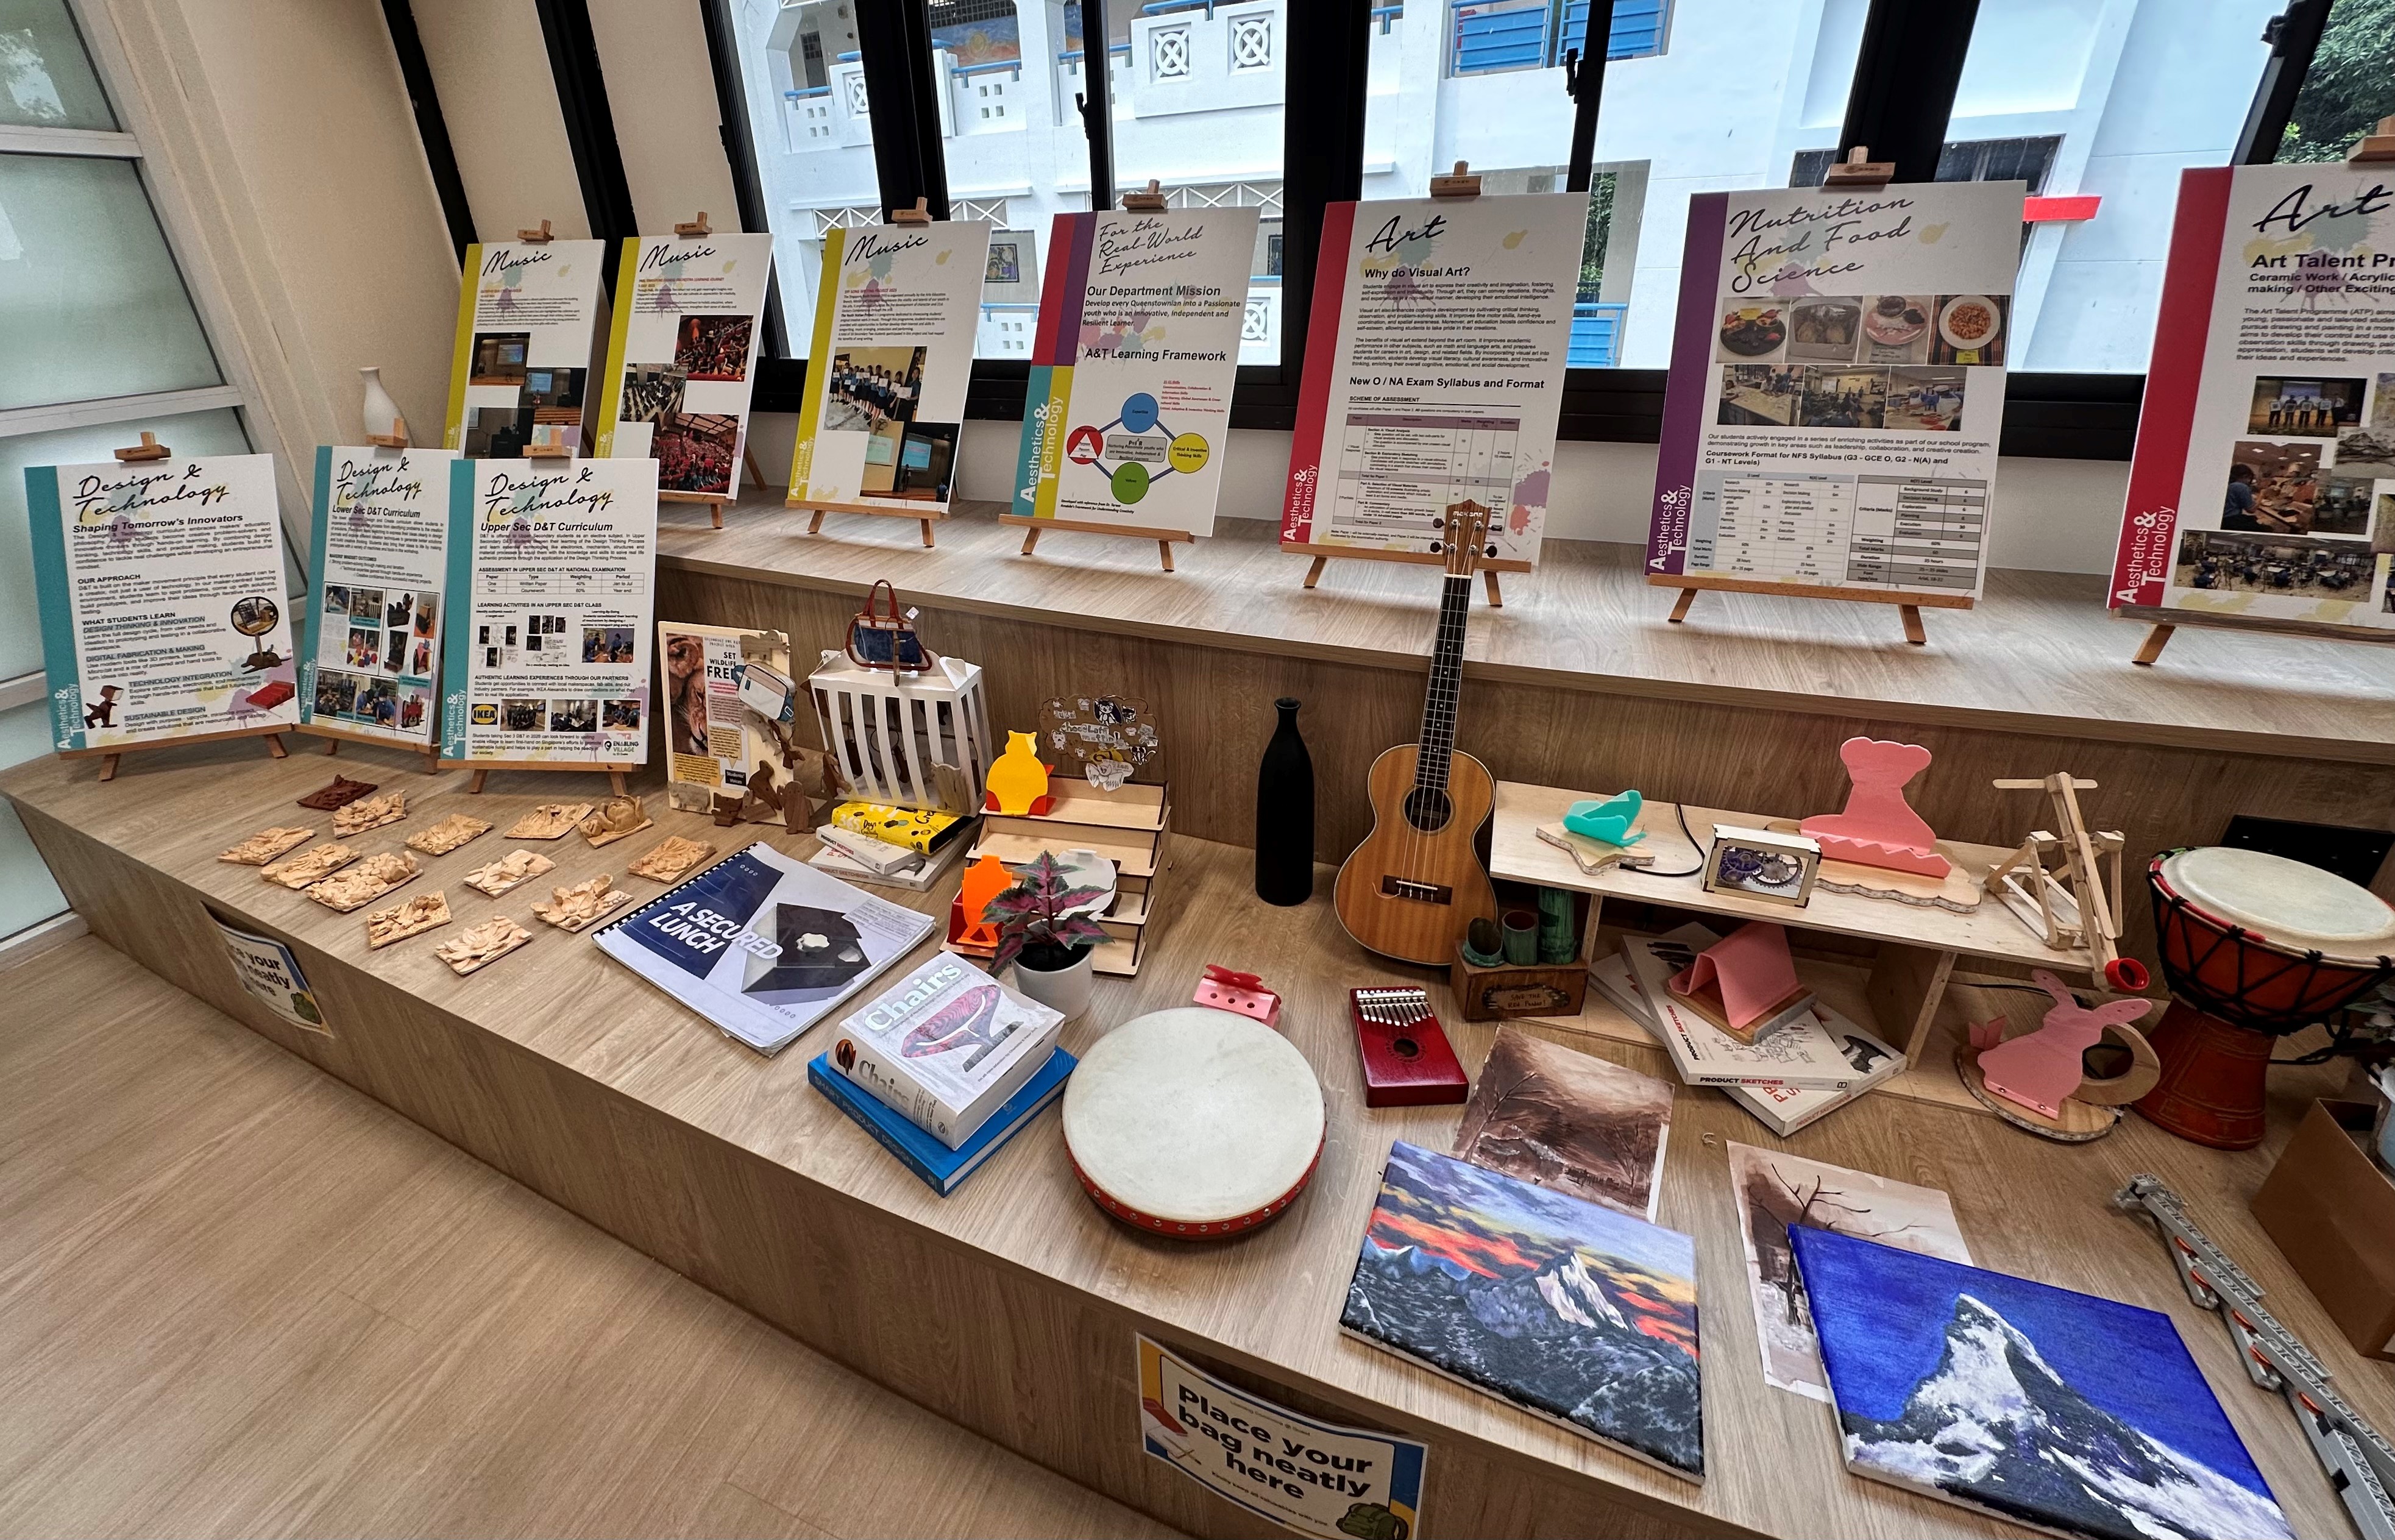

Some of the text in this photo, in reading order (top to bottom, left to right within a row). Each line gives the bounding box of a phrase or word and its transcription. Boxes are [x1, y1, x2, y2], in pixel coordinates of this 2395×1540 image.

[1730, 197, 1914, 238] Nutrition
[2252, 184, 2393, 232] Art
[1098, 226, 1203, 258] Real-World
[1099, 217, 1163, 241] For the
[1365, 215, 1446, 252] Art
[1731, 216, 1911, 265] And Food
[483, 250, 552, 276] Music
[639, 244, 716, 272] Music
[845, 233, 928, 265] Music
[1099, 250, 1197, 275] Experience
[2251, 255, 2287, 268] Art
[2294, 254, 2365, 268] Talent
[1365, 269, 1388, 280] Why
[1409, 268, 1442, 277] Visual
[1446, 267, 1470, 276] Art?
[1731, 260, 1864, 293] Science
[1087, 285, 1221, 296] Our Department Mission
[2248, 285, 2293, 294] making
[1085, 349, 1226, 362] A&T Learning Framework
[1383, 377, 1387, 386] /
[1389, 377, 1403, 386] NA
[1436, 378, 1480, 388] Syllabus
[1484, 378, 1502, 387] and
[1038, 397, 1063, 483] Technology
[337, 456, 409, 484] Design &
[799, 436, 815, 484] Technology
[73, 464, 201, 498] Design &
[337, 477, 422, 505] Technology
[484, 467, 592, 497] Design &
[1297, 464, 1318, 527] Technology
[75, 484, 229, 522] Technology
[383, 508, 420, 517] Curriculum
[485, 489, 613, 522] Technology
[73, 514, 243, 533] Shaping Tomorrow's Innovators
[481, 523, 510, 533] Upper
[558, 522, 612, 531] Curriculum
[1667, 484, 1691, 555] Technology
[2140, 505, 2176, 584] Technology
[98, 574, 140, 583] APPROACH
[107, 615, 147, 623] STUDENTS
[129, 671, 232, 687] TECHNOLOGY INTEGRATION
[707, 666, 734, 680] FRE
[68, 684, 85, 737] Technology
[124, 706, 205, 721] SUSTAINABLE DESIGN
[454, 689, 466, 741] Technology
[474, 710, 495, 719] IKEA
[821, 834, 836, 845] PRODUCT
[648, 912, 726, 955] LUNCH
[670, 901, 785, 960] A SECURED
[246, 952, 280, 970] your
[247, 965, 290, 990] neatly
[864, 963, 962, 1031] Chairs
[1681, 1033, 1700, 1060] PRODUCT
[858, 1060, 909, 1110] Chairs
[814, 1076, 840, 1101] SMART
[842, 1100, 879, 1137] PRODUCT
[881, 1134, 914, 1166] DESIGN
[1178, 1384, 1271, 1443] Place
[1282, 1438, 1372, 1474] your
[1178, 1404, 1242, 1453] bag
[1253, 1446, 1371, 1497] neatly
[1226, 1451, 1305, 1499] here
